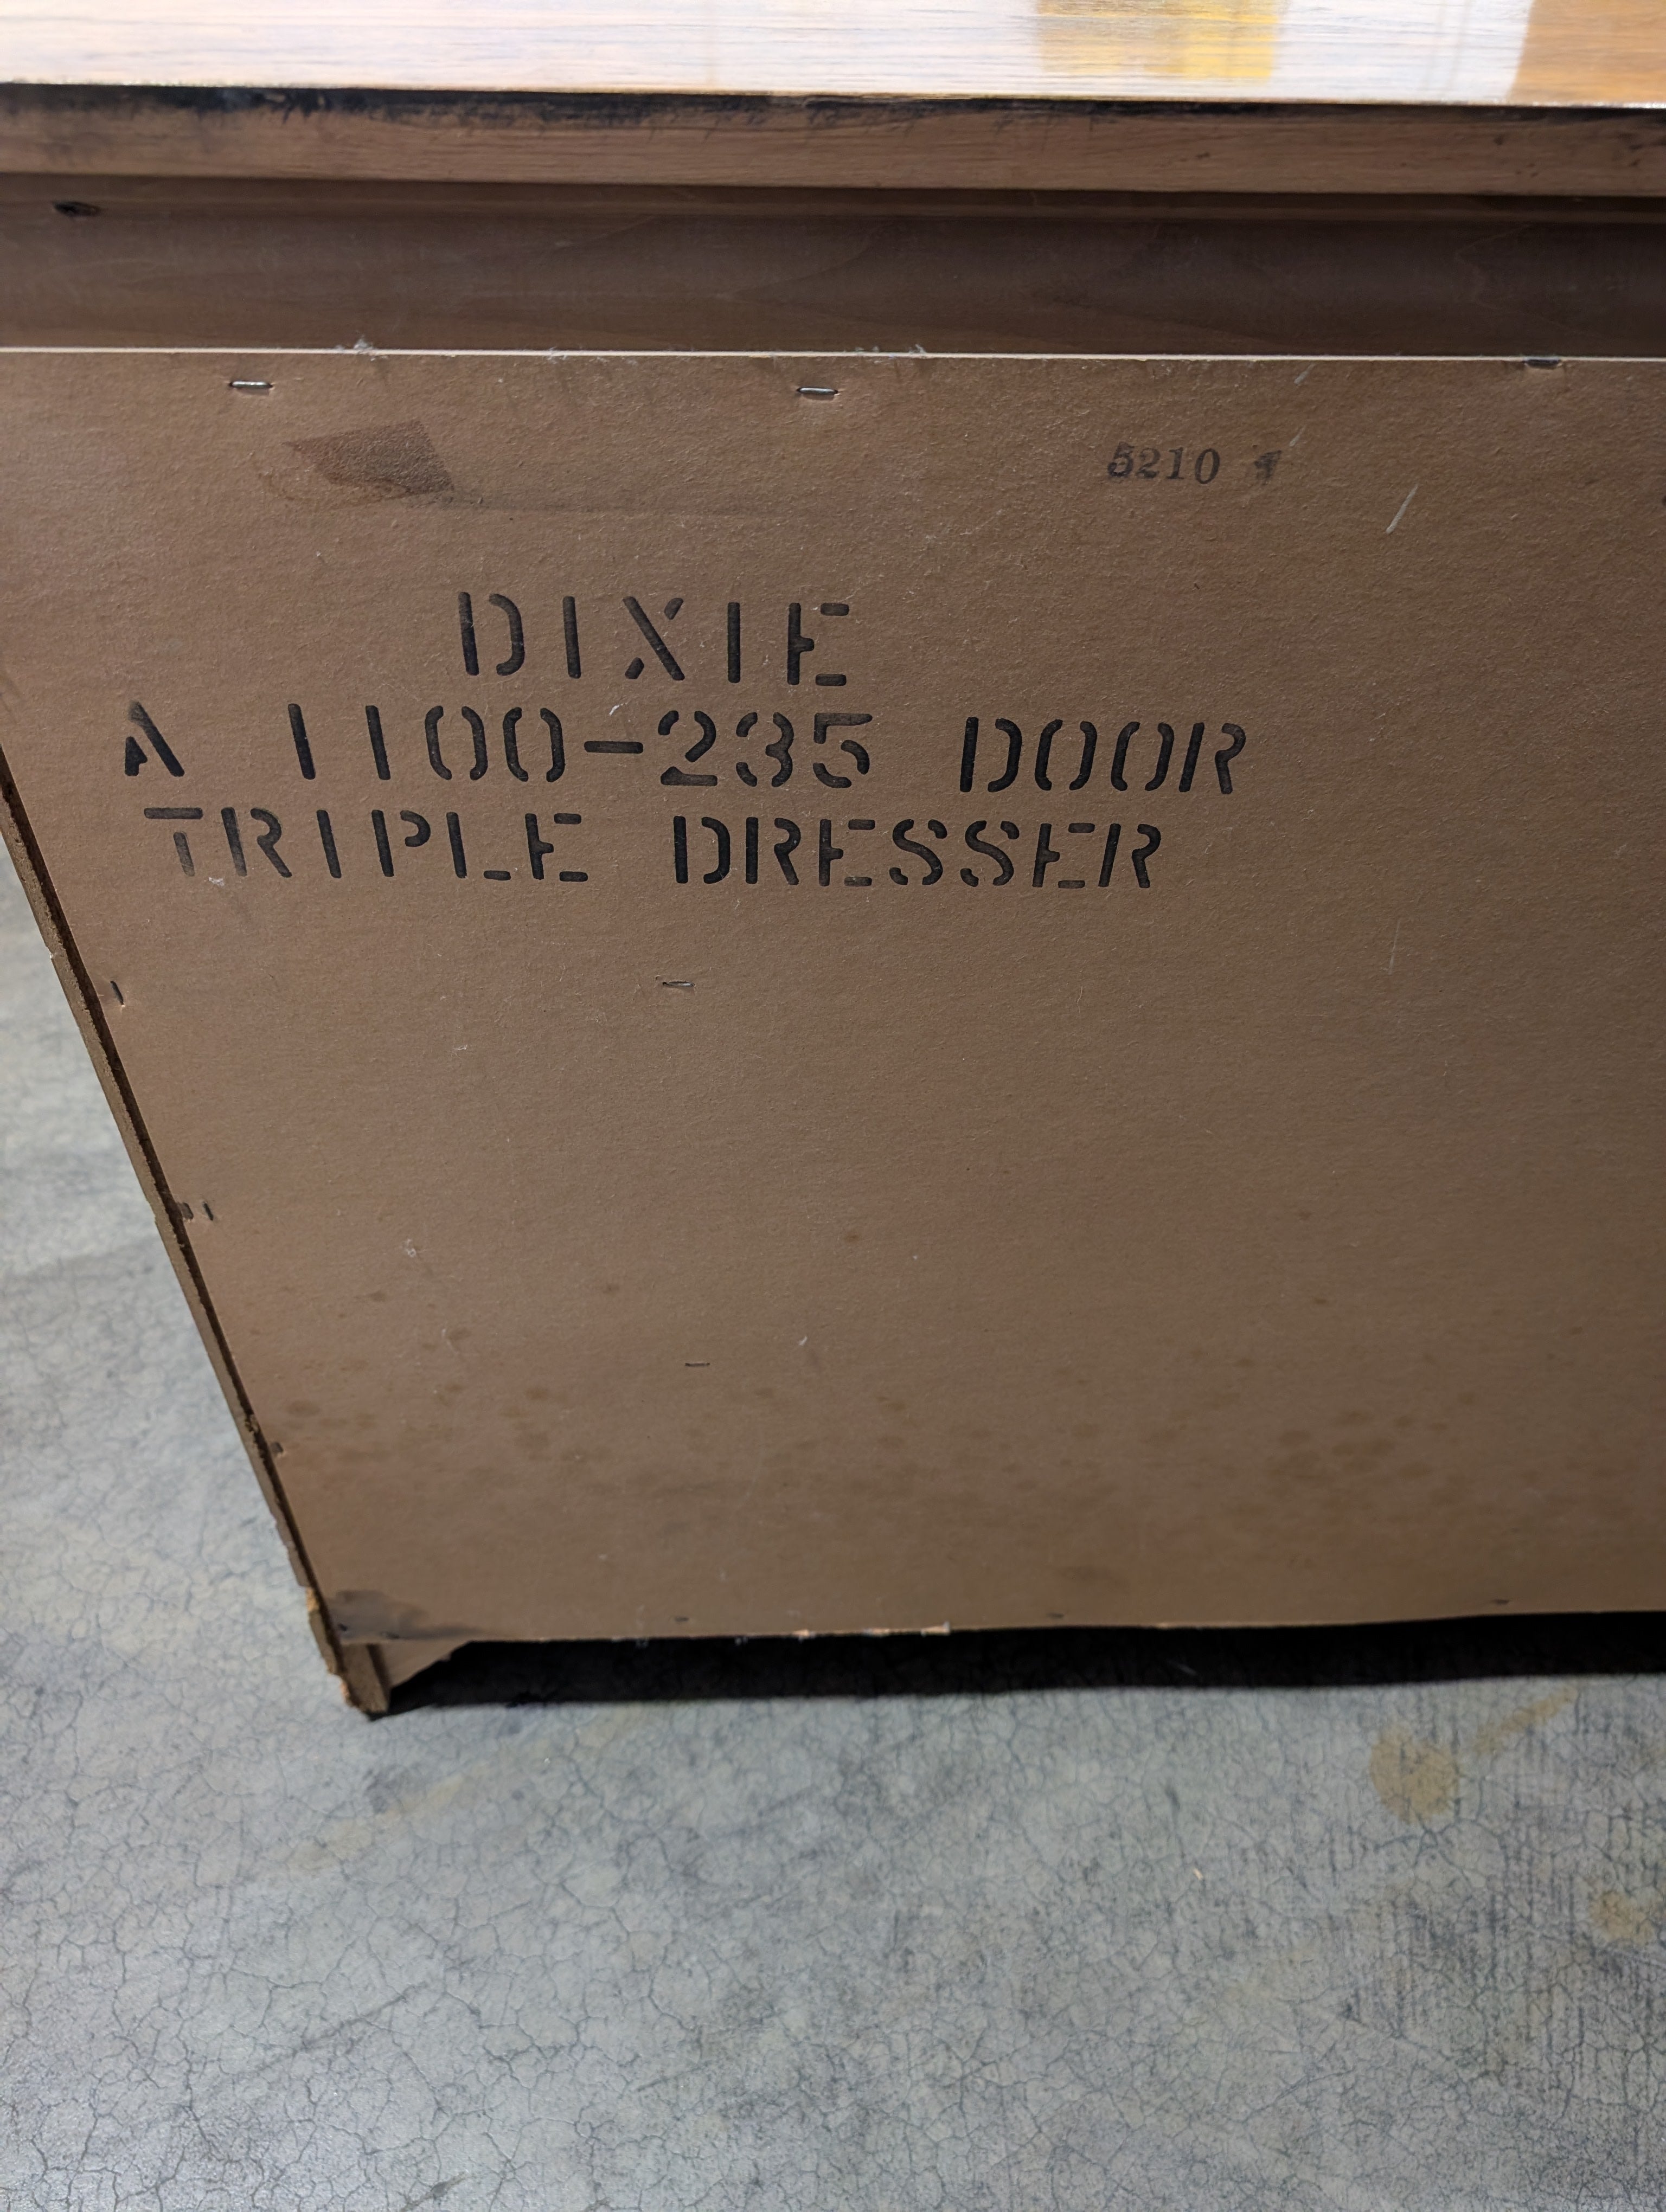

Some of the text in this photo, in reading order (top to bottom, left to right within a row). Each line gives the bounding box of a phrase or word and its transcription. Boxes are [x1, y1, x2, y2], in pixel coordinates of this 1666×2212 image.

[459, 591, 849, 686] DIXIE
[124, 700, 1246, 795] A 1100-235 DOOR
[143, 806, 1161, 889] TRIPLE DRESSER
